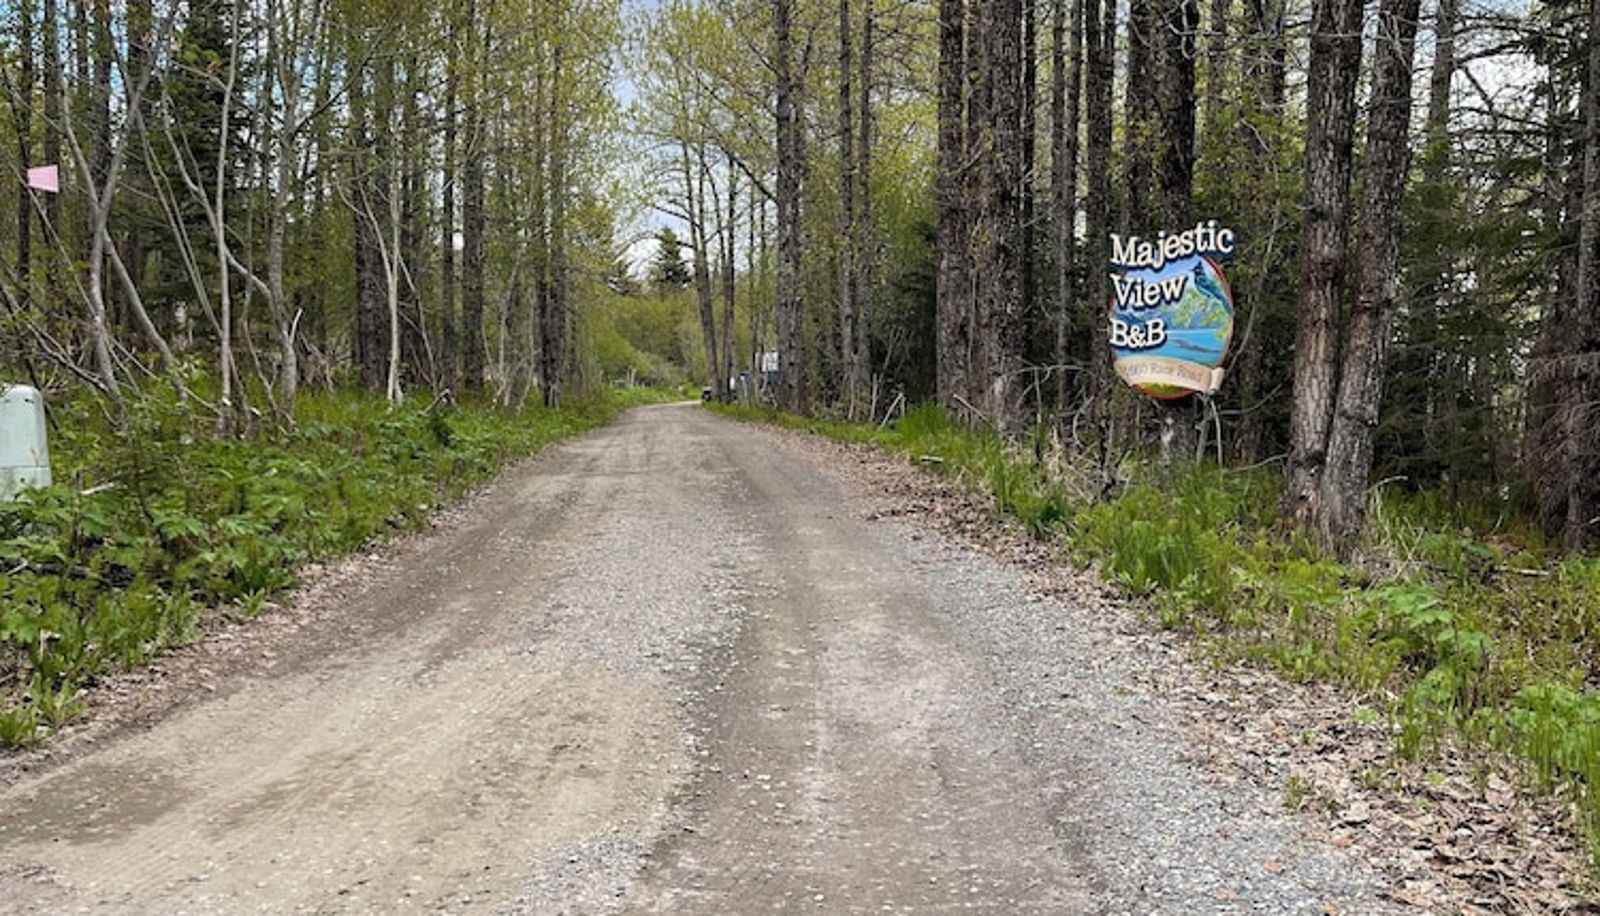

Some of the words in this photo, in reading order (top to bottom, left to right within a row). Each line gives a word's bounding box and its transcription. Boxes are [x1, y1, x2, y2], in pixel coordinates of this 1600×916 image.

[1109, 220, 1234, 268] Majestic
[1109, 273, 1187, 307] View
[1110, 318, 1166, 348] B&B
